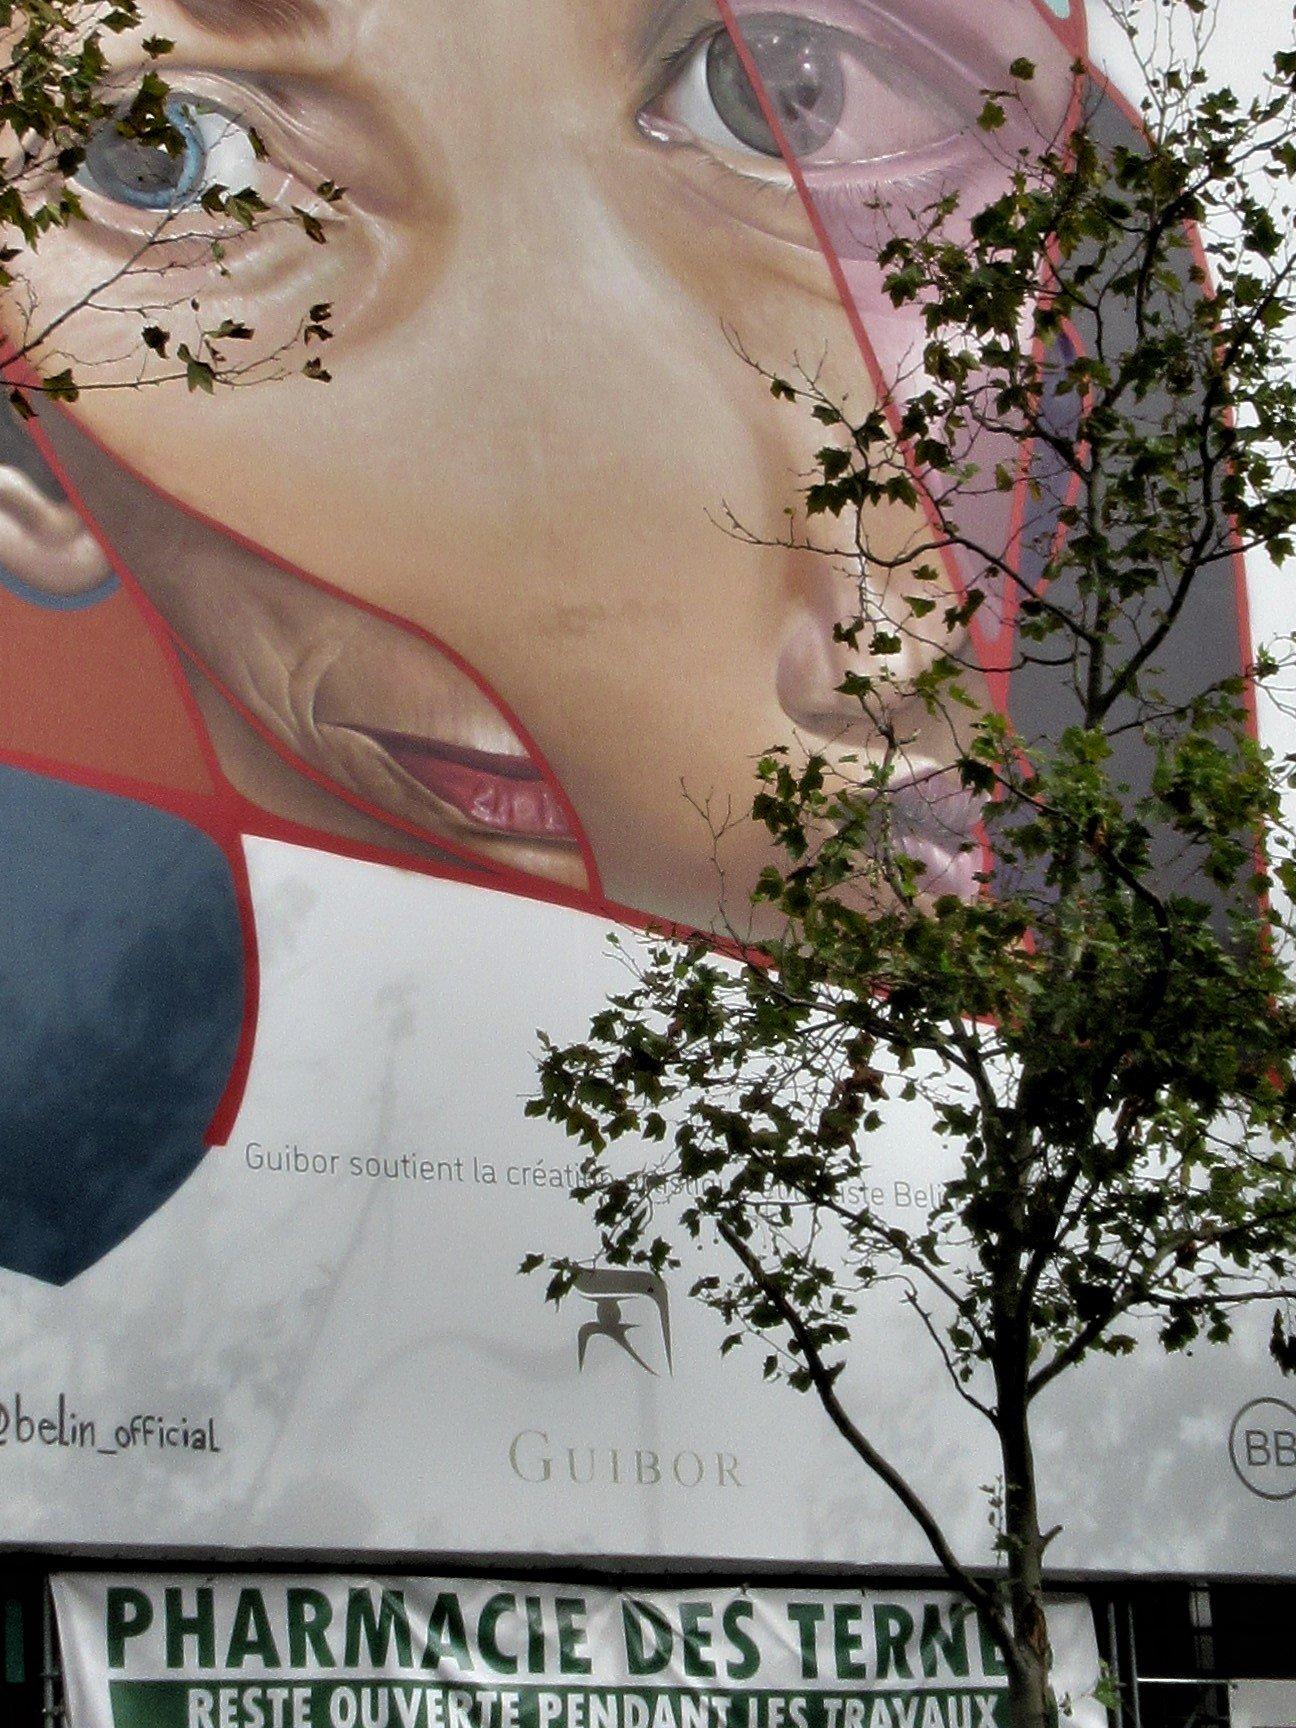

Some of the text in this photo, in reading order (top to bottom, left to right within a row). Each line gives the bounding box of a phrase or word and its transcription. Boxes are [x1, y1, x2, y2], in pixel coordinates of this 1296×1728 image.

[245, 1142, 340, 1174] Guibor
[350, 1153, 464, 1182] soutient
[473, 1157, 497, 1184] la
[894, 1181, 960, 1210] Beli
[508, 1429, 746, 1488] GUIBOR
[107, 1586, 1009, 1680] PHARMACIE DES TERNE
